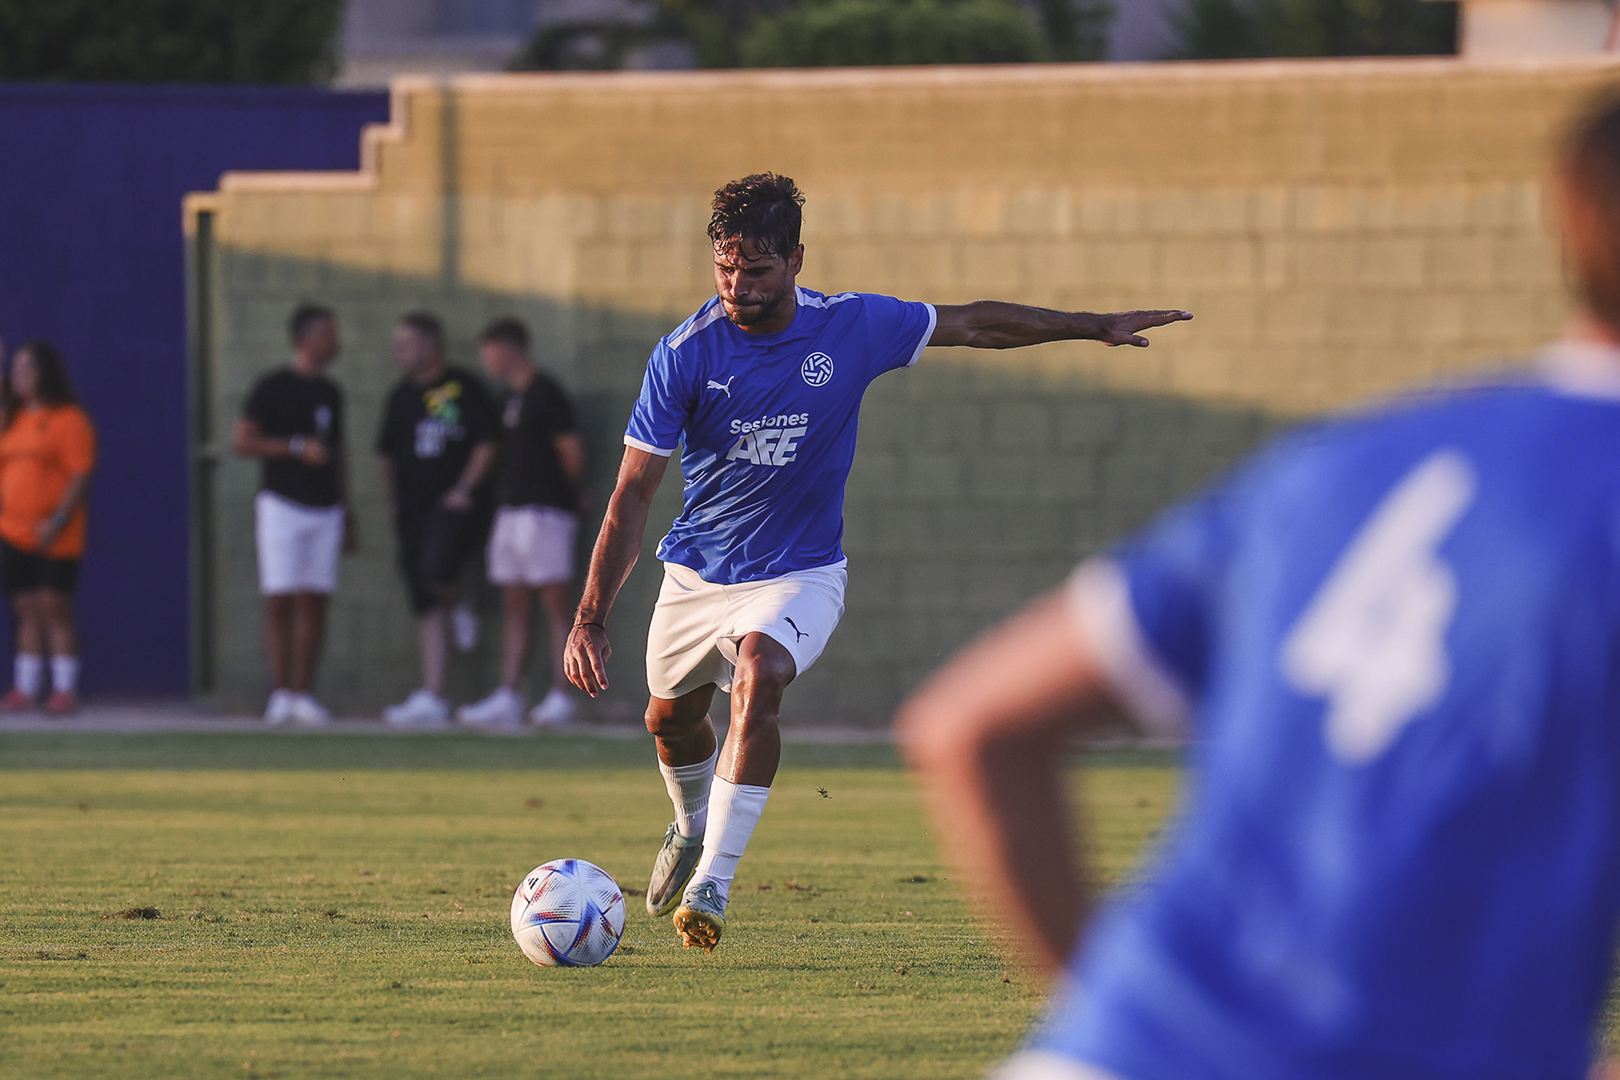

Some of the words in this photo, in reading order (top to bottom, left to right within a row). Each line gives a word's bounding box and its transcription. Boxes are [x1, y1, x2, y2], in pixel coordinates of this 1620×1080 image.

[729, 412, 809, 435] Sesiones
[725, 426, 808, 467] AFE
[1279, 448, 1478, 767] 4
